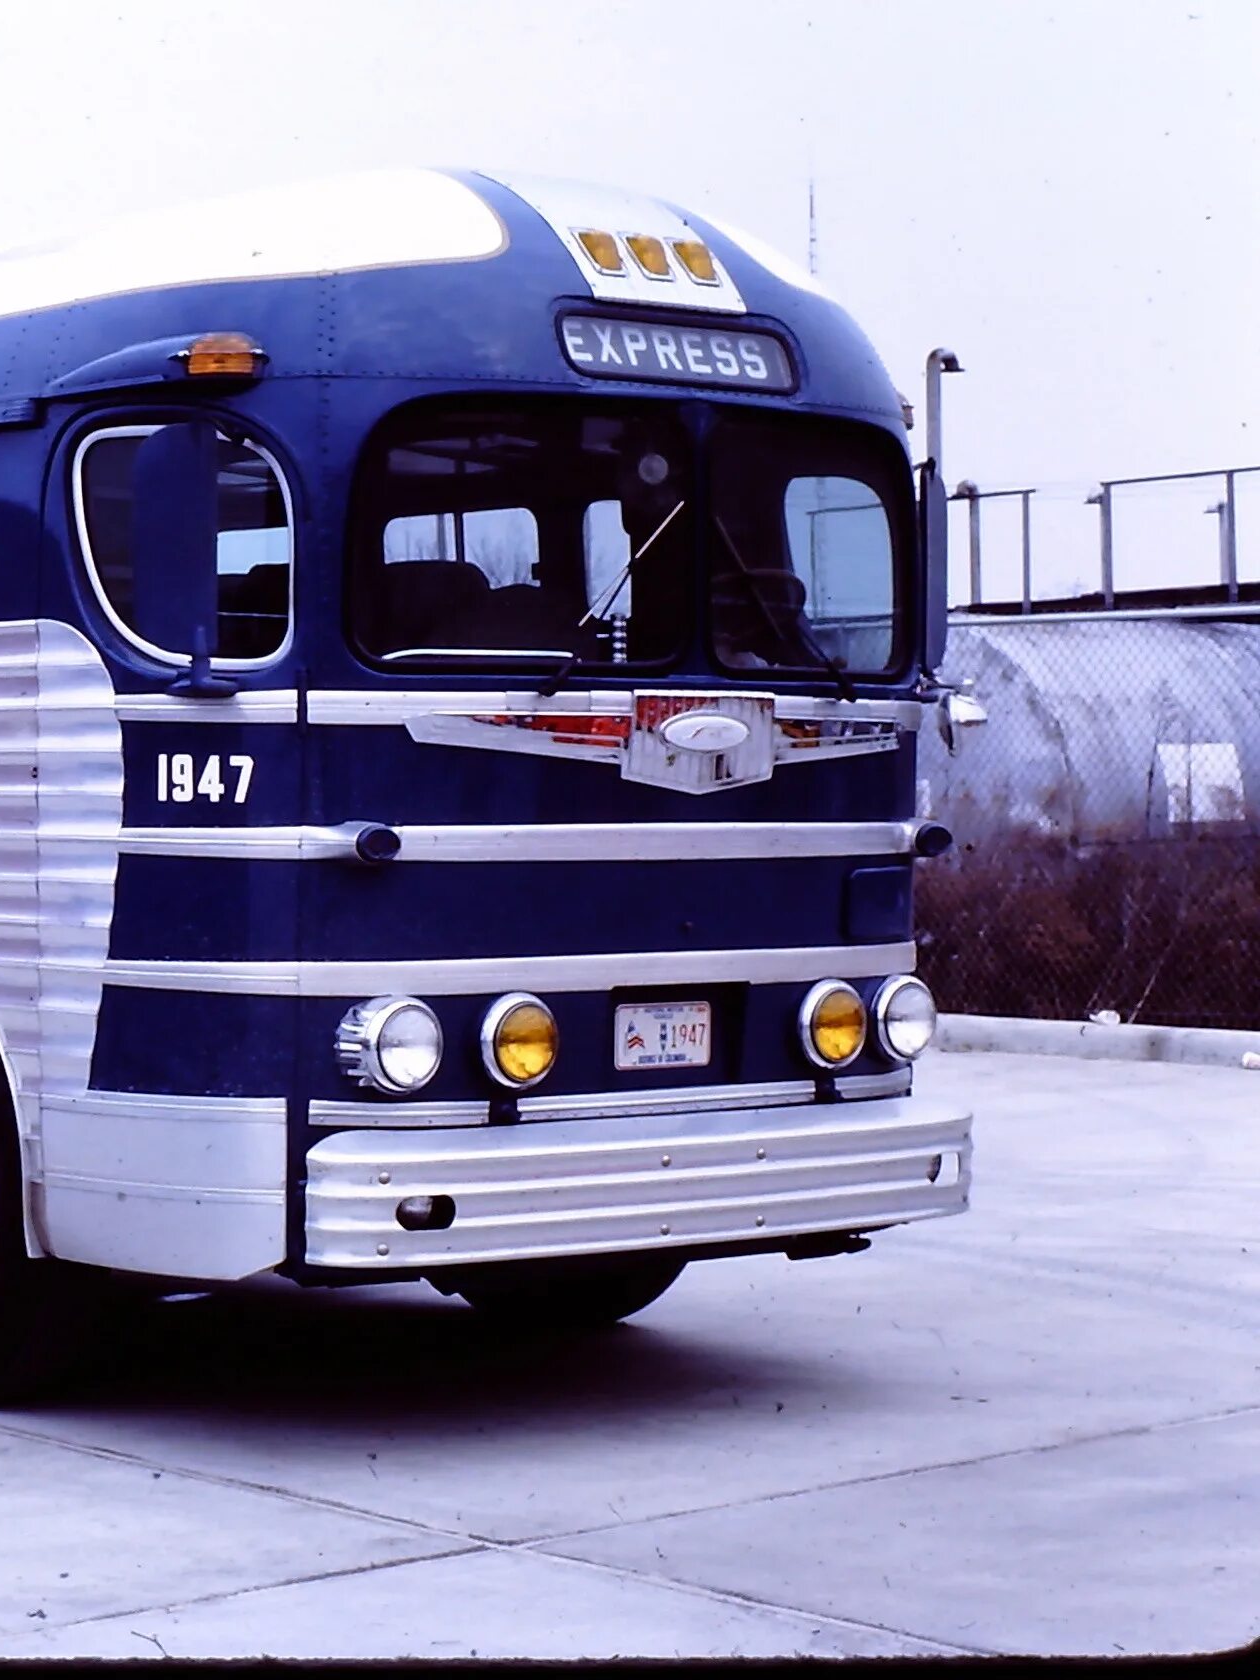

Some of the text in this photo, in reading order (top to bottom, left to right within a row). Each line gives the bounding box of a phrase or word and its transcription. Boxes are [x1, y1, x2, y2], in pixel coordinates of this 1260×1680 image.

[562, 316, 769, 380] EXPRESS
[157, 753, 255, 804] 1947
[671, 1022, 706, 1048] 1947
